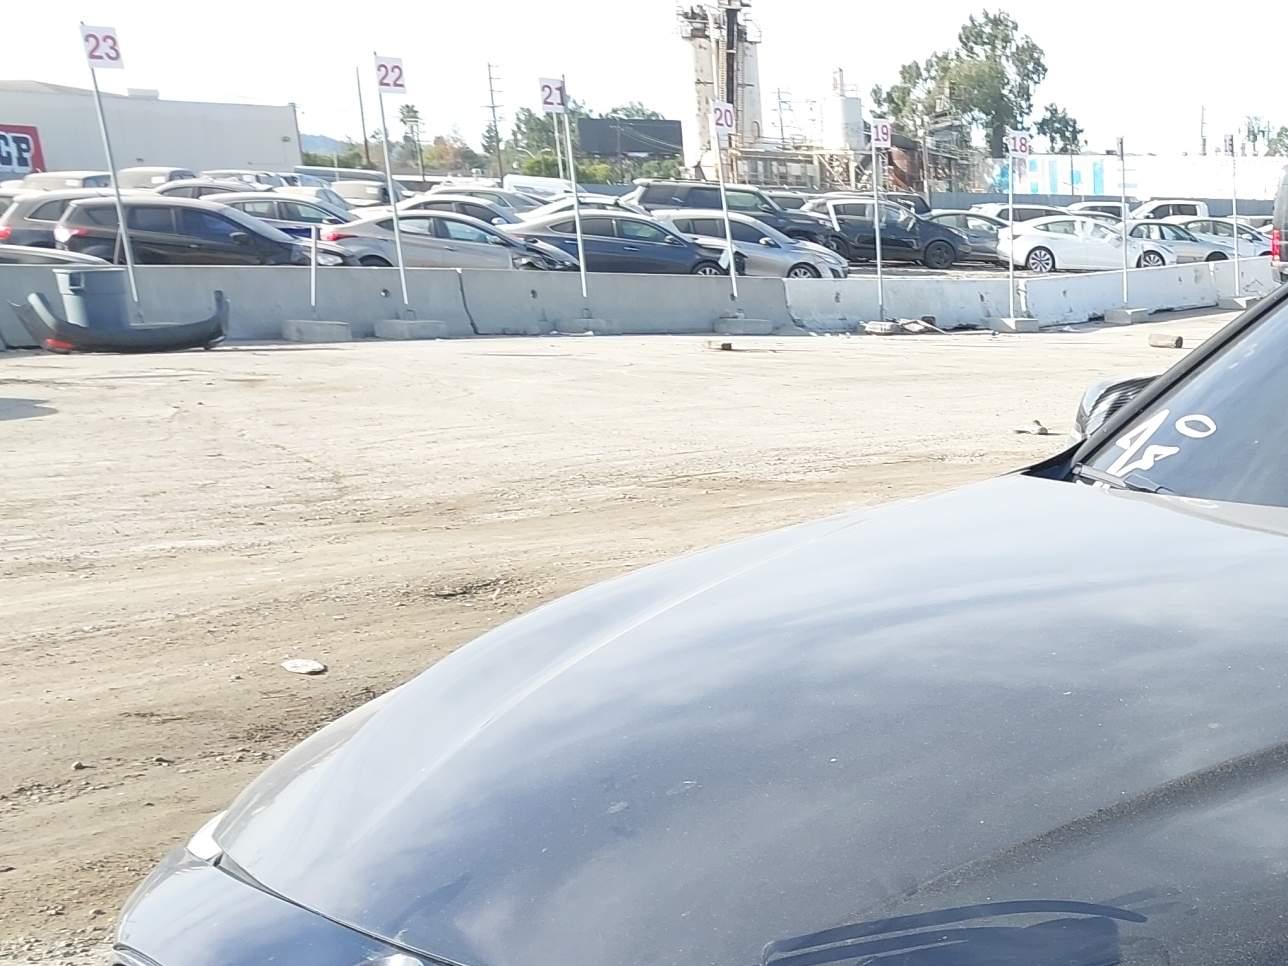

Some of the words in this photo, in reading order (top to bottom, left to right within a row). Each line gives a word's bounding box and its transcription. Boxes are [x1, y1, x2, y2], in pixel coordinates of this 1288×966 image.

[84, 33, 120, 61] 23
[377, 63, 406, 88] 22
[541, 84, 566, 107] 21
[714, 107, 734, 128] 20
[873, 124, 889, 142] 19
[1010, 136, 1028, 153] 18
